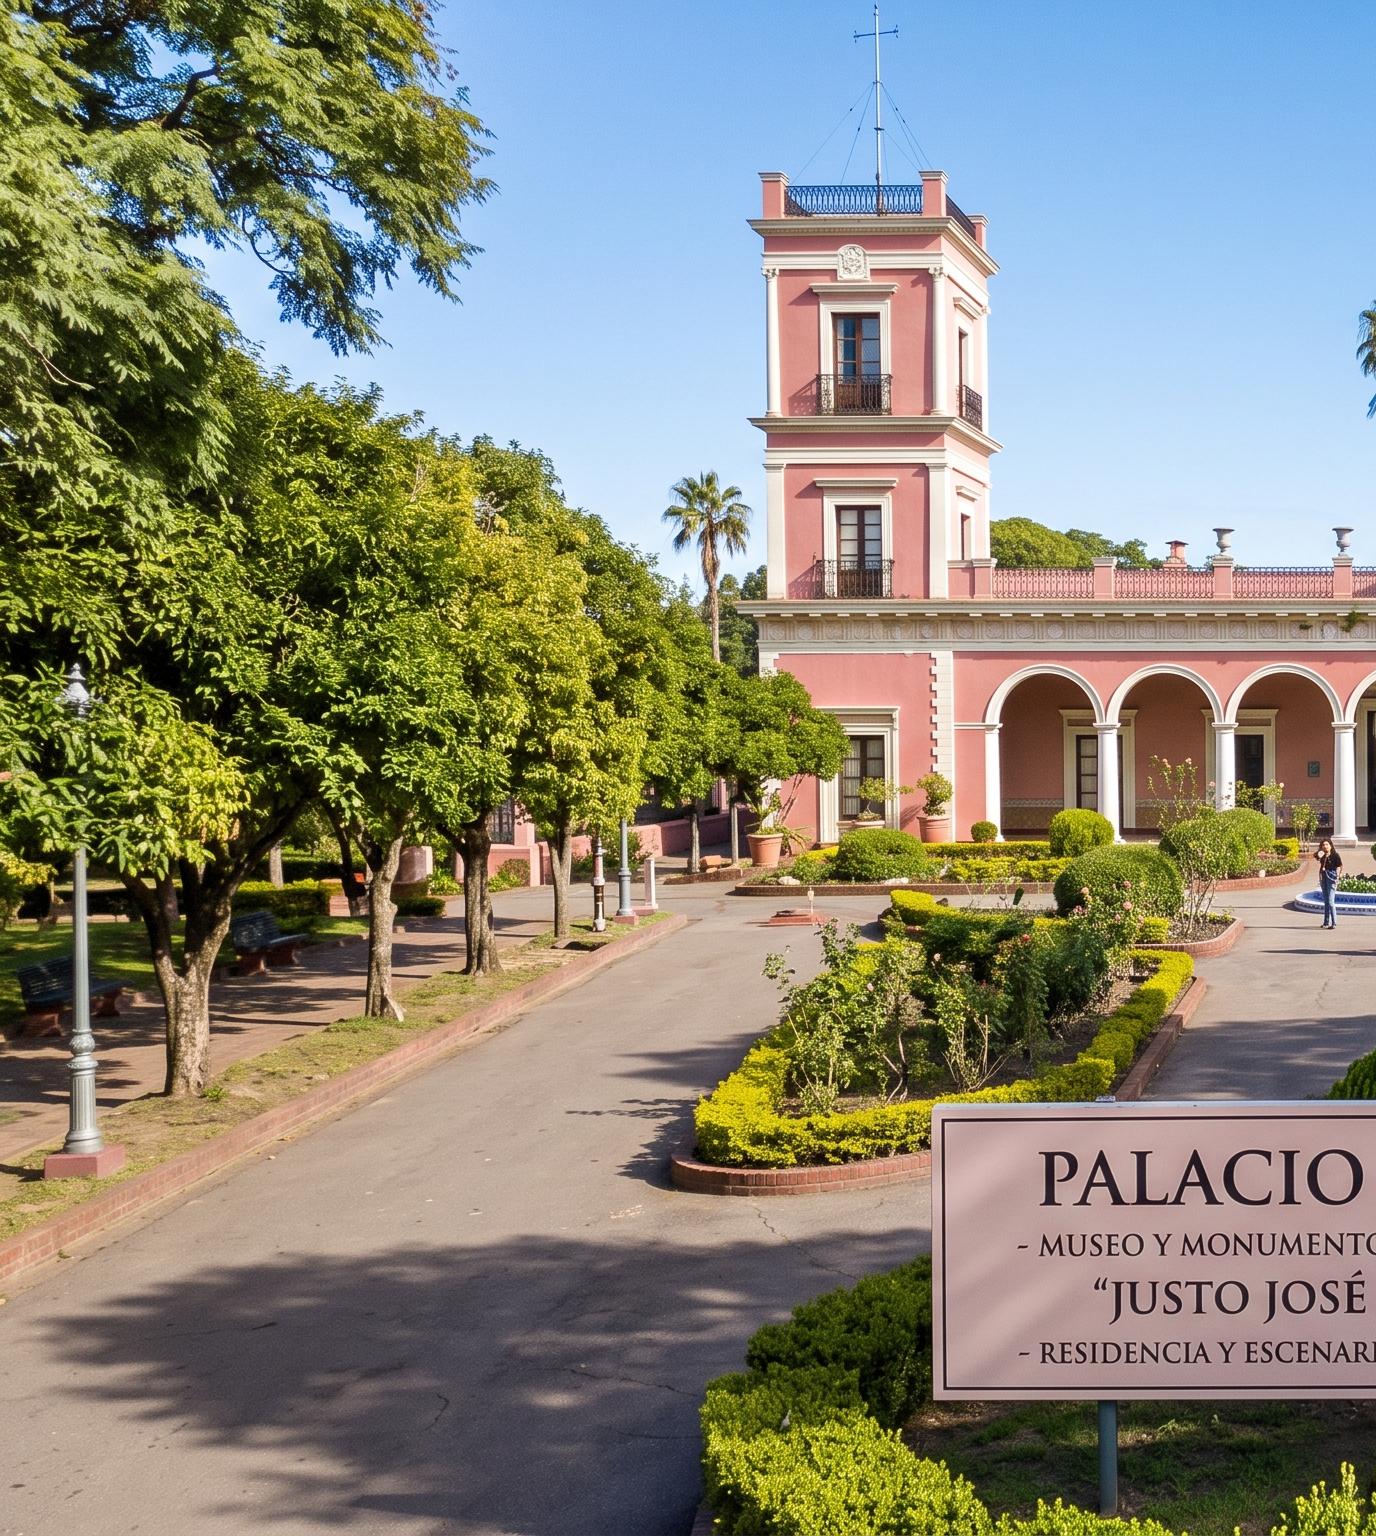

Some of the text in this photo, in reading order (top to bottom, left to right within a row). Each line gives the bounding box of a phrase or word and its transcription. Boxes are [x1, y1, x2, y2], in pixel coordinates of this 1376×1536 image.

[1038, 1148, 1364, 1207] PALACIO
[1038, 1233, 1145, 1257] MUSEO
[1151, 1233, 1173, 1257] Y
[1262, 1269, 1367, 1325] JOSÉ
[1038, 1341, 1213, 1365] RESIDENCIA
[1216, 1341, 1238, 1364] Y
